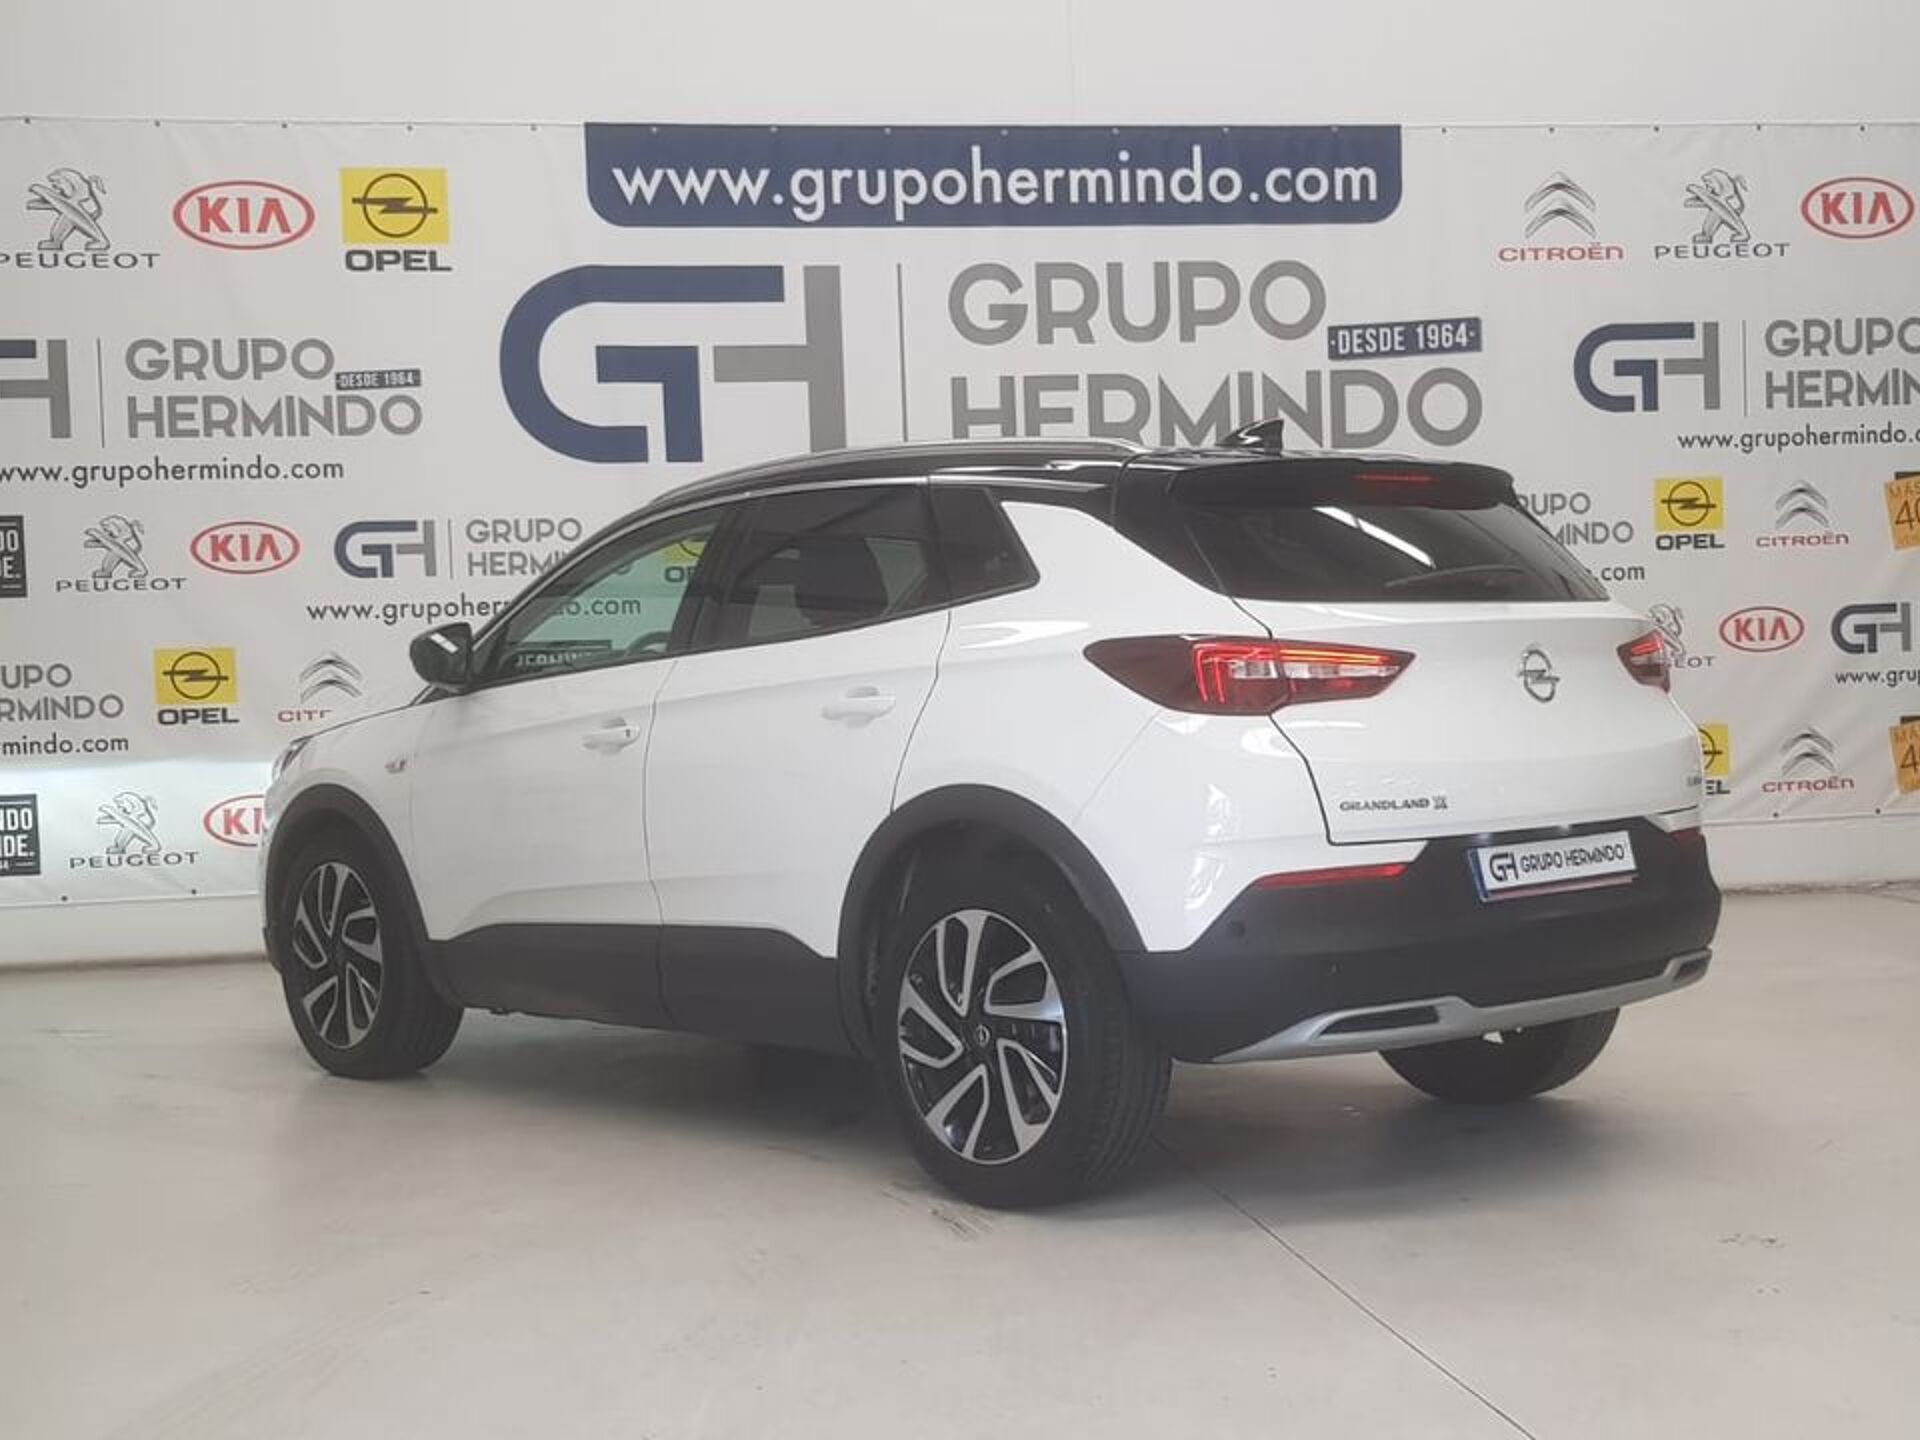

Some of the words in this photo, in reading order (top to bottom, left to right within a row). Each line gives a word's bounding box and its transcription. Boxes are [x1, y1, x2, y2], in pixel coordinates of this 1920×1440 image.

[611, 147, 1377, 222] www.grupohermindo.com
[198, 197, 289, 234] KIA
[1821, 192, 1895, 225] KIA
[346, 250, 452, 271] OPEL
[1499, 243, 1624, 262] CITROËN
[1655, 243, 1790, 260] PEUGEOT
[949, 260, 1327, 346] GRUPO
[1764, 318, 1920, 358] GRUPO
[125, 338, 335, 381] GRUPO
[1573, 321, 1722, 413] GH
[340, 373, 379, 388] DESDE
[384, 372, 415, 386] 1964
[128, 394, 423, 438] HERMINDO
[950, 367, 1483, 449] HERMINDO
[0, 455, 345, 488] www.grupohermindo.com
[465, 518, 583, 543] GRUPO
[1656, 535, 1725, 551] OPEL
[210, 534, 282, 562] KIA
[335, 520, 437, 578] GH
[56, 577, 188, 592] PEUGEOT
[1734, 617, 1790, 642] KIA
[1831, 602, 1911, 654] GH
[1, 663, 72, 690] UPO
[158, 707, 240, 725] OPEL
[1705, 779, 1731, 796] EL
[1339, 797, 1430, 811] GRANDLAND
[224, 807, 269, 835] KI
[70, 852, 200, 870] PEUGEOT
[1521, 852, 1562, 873] GRUPO
[1565, 843, 1625, 867] HERMINDO
